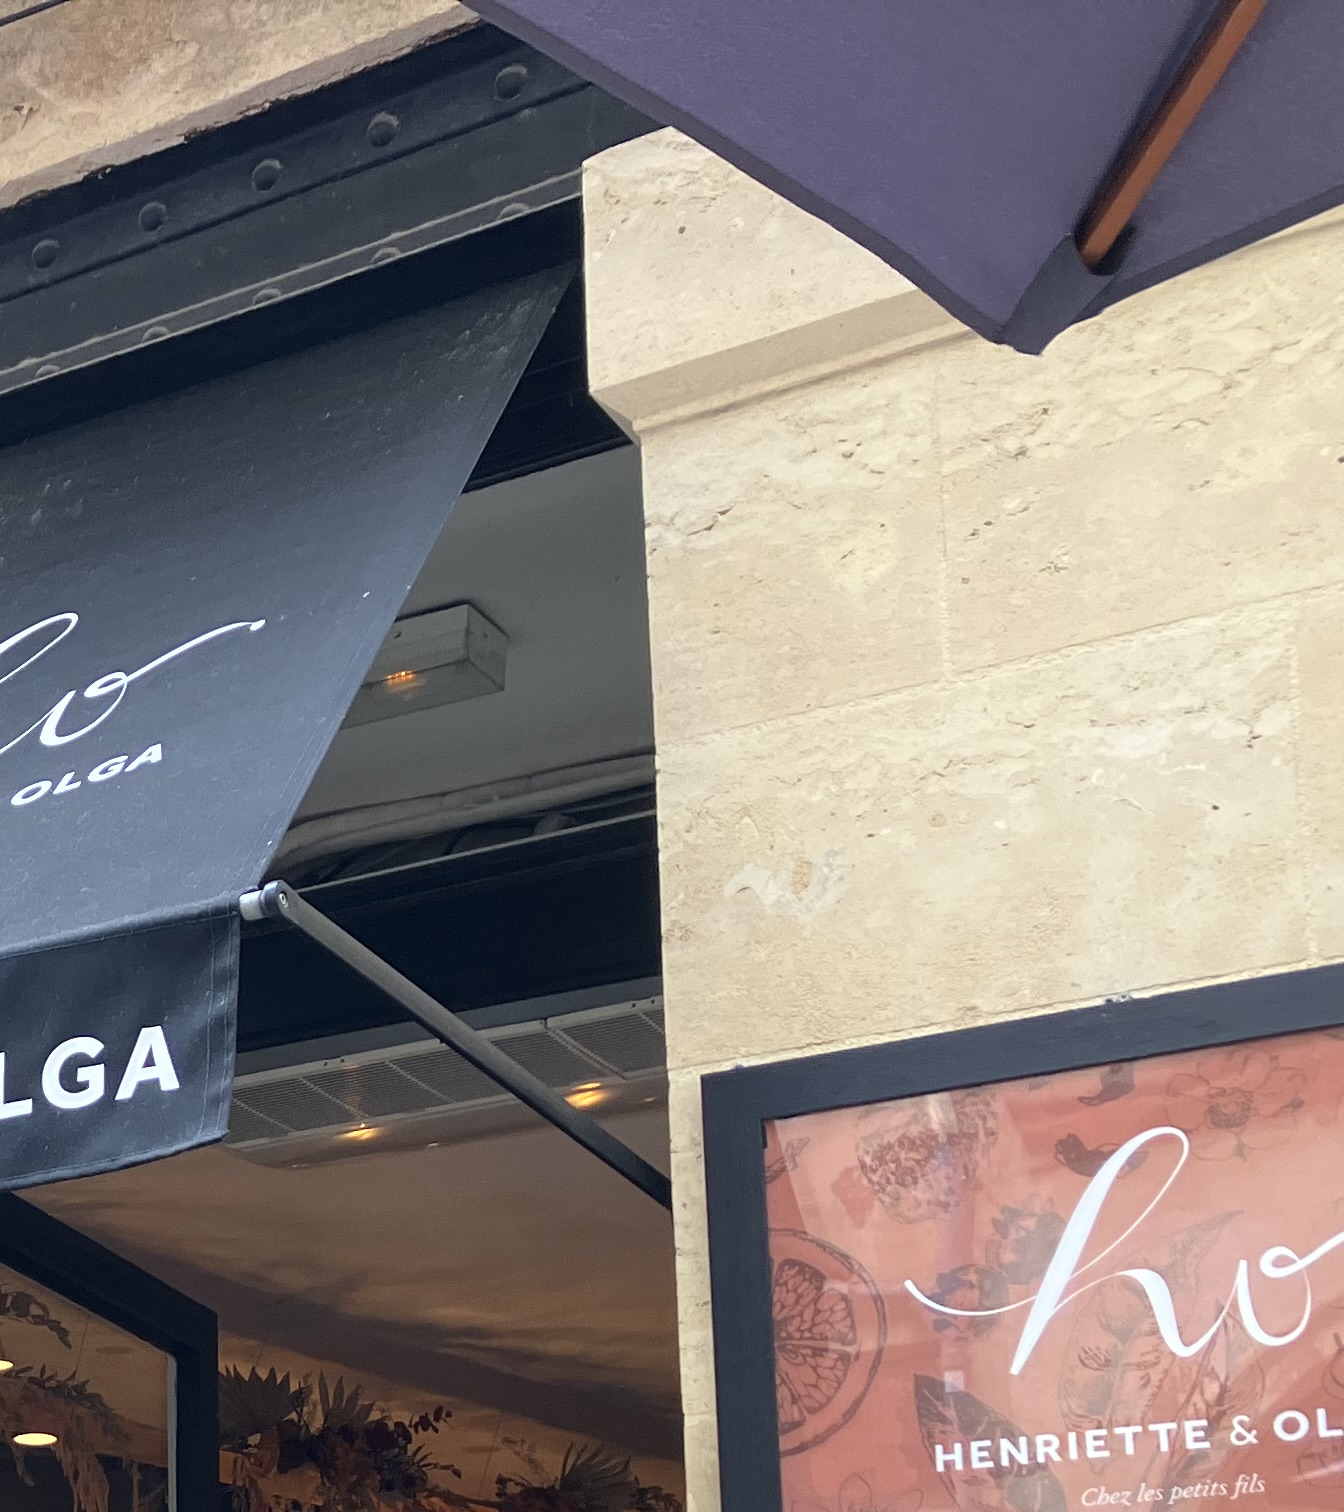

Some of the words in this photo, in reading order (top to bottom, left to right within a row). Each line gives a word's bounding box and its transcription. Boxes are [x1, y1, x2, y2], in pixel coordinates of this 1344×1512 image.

[11, 743, 163, 806] OLGA
[934, 1419, 1210, 1473] HENRIETTE
[1230, 1415, 1258, 1446] &
[1272, 1407, 1344, 1443] OL
[1081, 1487, 1132, 1507] Chez
[1137, 1483, 1165, 1502] les
[1168, 1478, 1228, 1505] petits
[1229, 1473, 1266, 1500] fils
